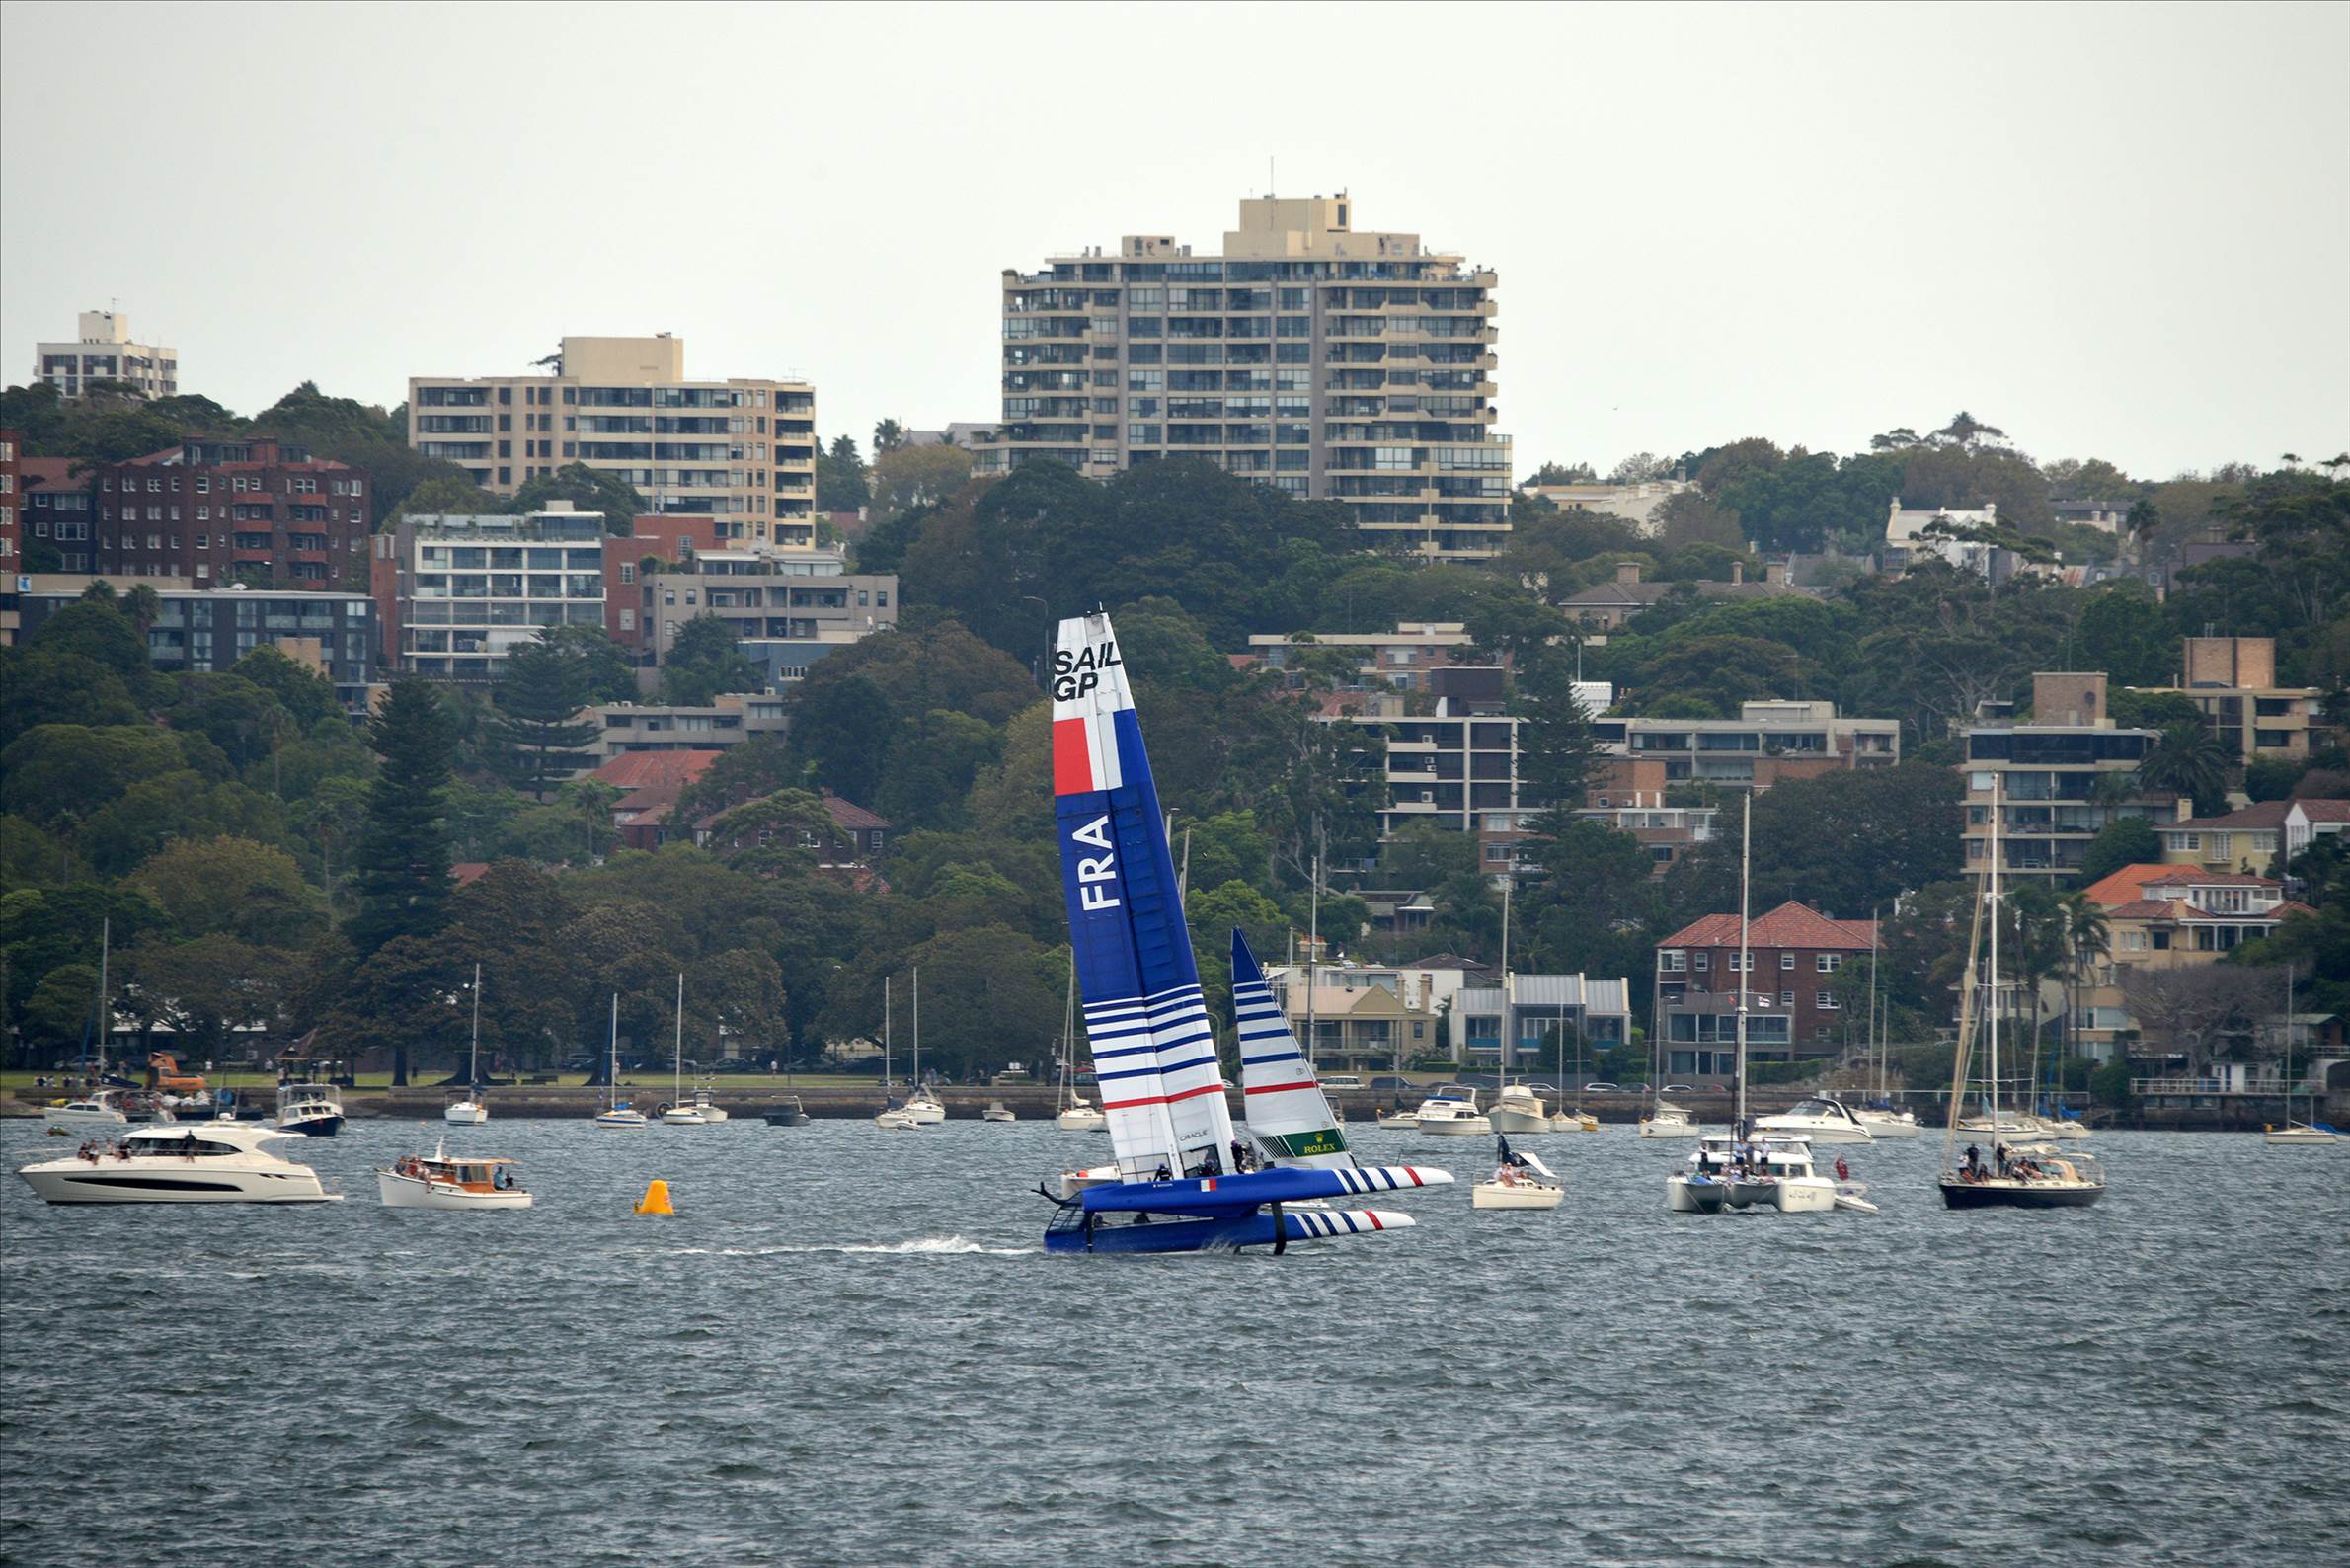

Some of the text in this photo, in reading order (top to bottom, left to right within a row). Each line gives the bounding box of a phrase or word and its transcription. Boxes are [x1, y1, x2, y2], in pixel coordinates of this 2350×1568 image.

[1054, 642, 1122, 675] SAIL
[1053, 672, 1099, 702] GP
[1072, 815, 1121, 911] FRA
[1304, 1143, 1336, 1154] ROLEX
